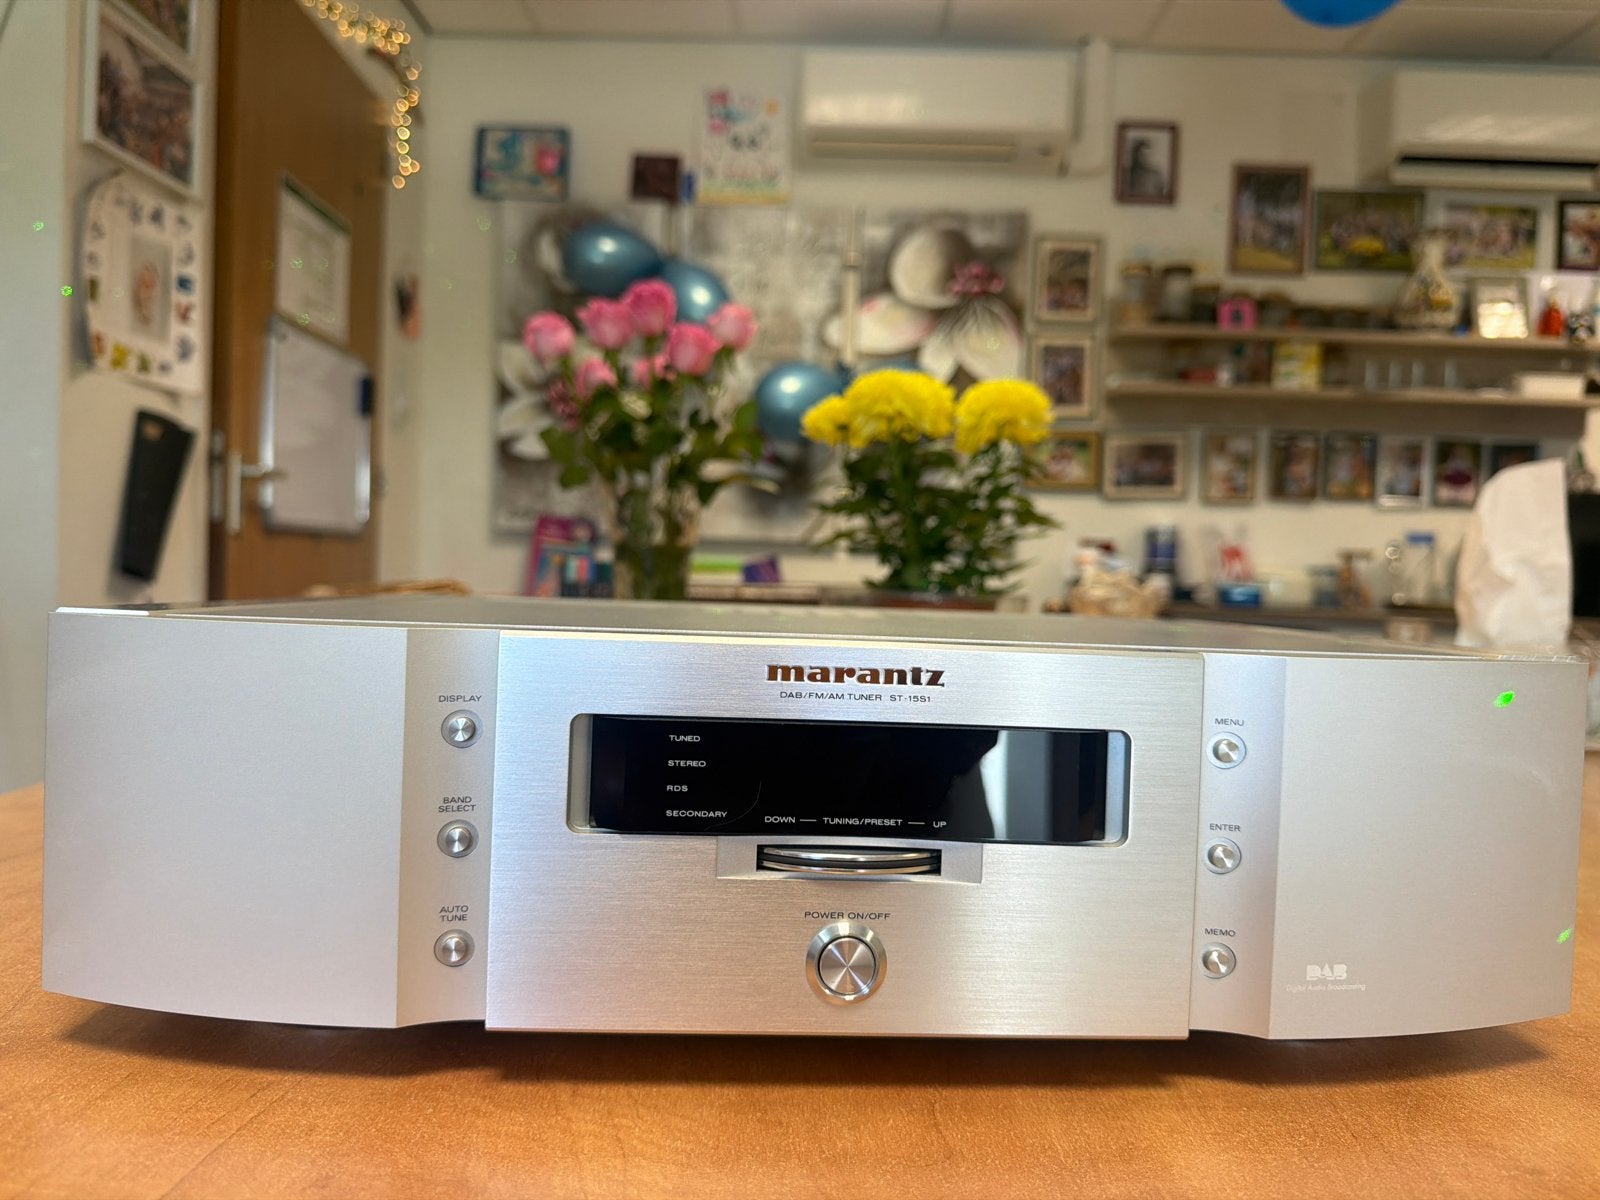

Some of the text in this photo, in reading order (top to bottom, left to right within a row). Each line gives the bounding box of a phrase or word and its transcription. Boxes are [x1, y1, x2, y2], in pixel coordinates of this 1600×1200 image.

[766, 664, 945, 688] marantz
[438, 694, 482, 703] DISPLAY
[780, 691, 931, 703] DAB/FM/AM TUNER ST-15S1
[1214, 717, 1245, 727] MENU
[668, 734, 701, 743] TUNED
[667, 759, 707, 768] STEREO
[666, 784, 689, 792] RDS
[442, 795, 473, 805] BAND
[438, 804, 477, 813] SELECT
[665, 808, 728, 819] SECONDARY
[764, 815, 947, 829] DOWN TUNING/PRESET UP
[1209, 823, 1241, 832] ENTER
[439, 904, 470, 914] AUTO
[439, 913, 469, 922] TUNE
[804, 911, 892, 921] POWER ON/OFF
[1204, 927, 1236, 937] MEMO
[1306, 961, 1348, 981] DAB
